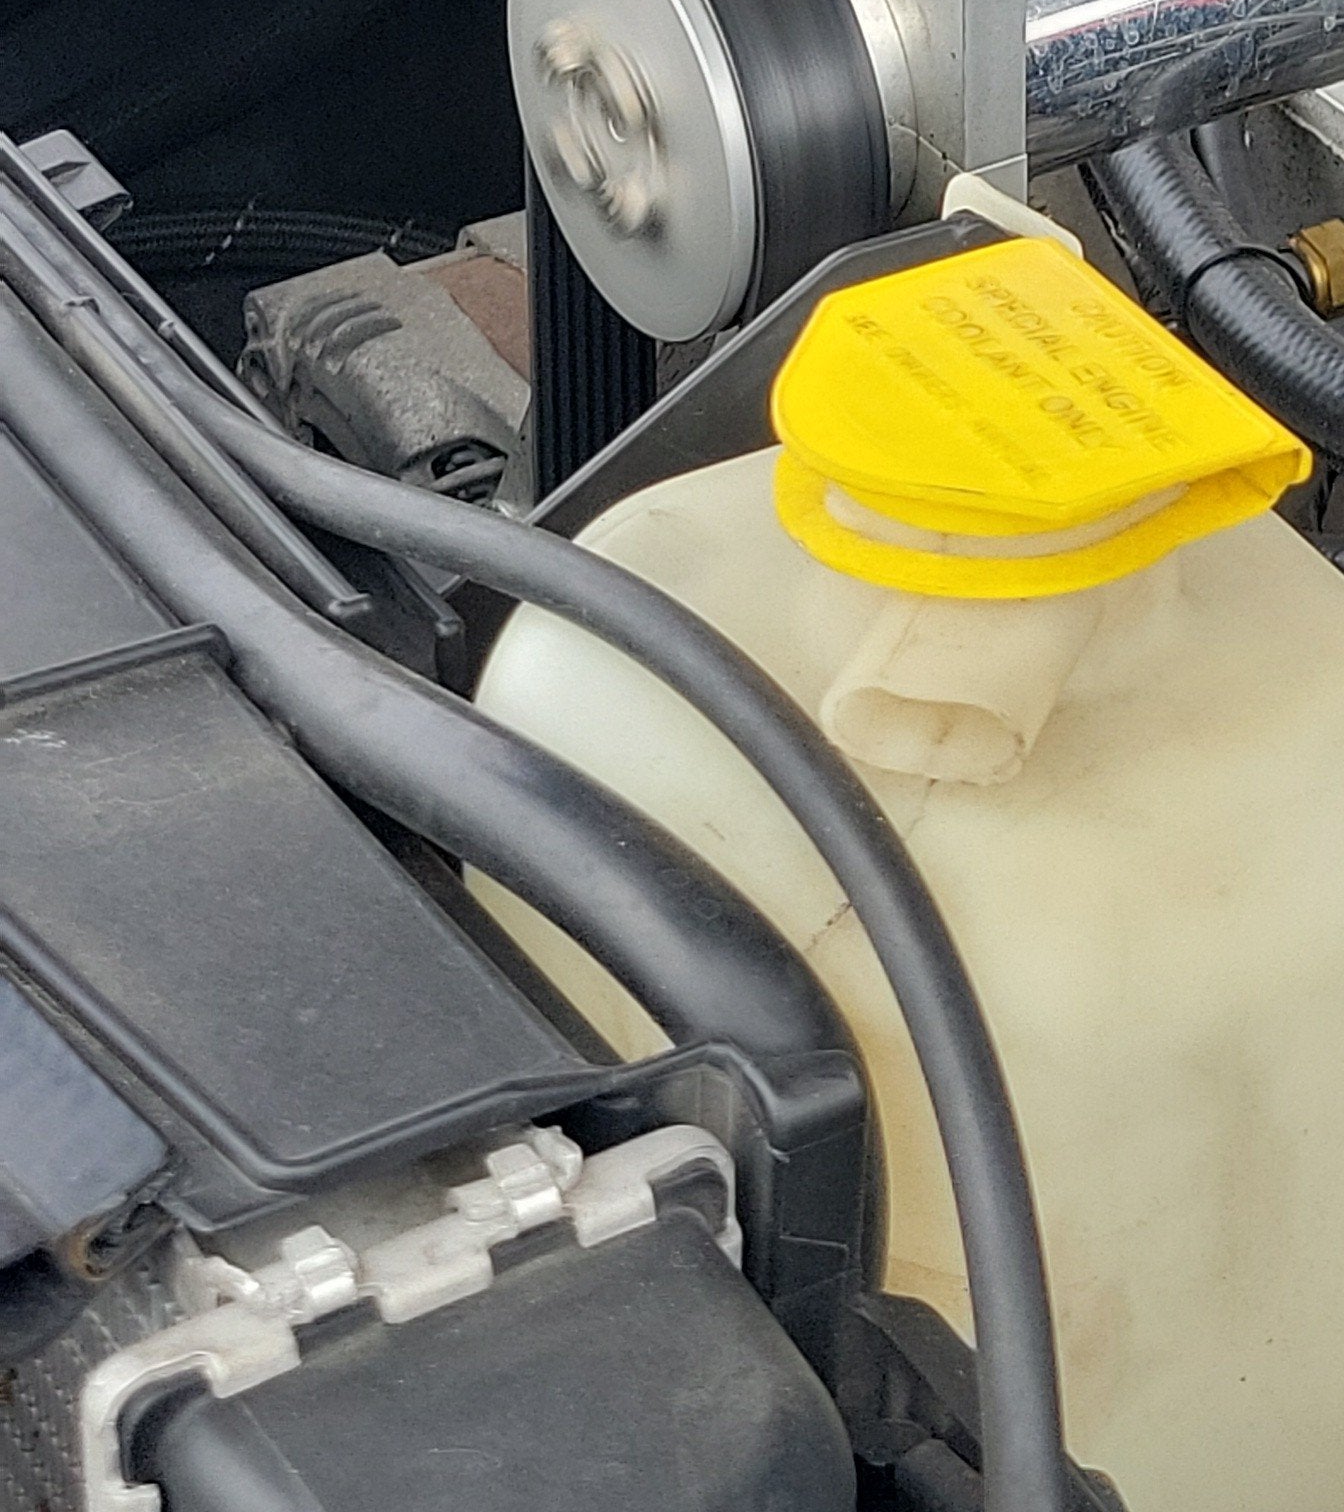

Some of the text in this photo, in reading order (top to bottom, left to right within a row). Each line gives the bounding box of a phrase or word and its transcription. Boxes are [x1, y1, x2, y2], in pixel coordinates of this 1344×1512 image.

[920, 295, 1057, 392] COOLANT
[1038, 392, 1130, 453] ONLY
[964, 274, 1080, 363] SPECIAL
[1067, 361, 1190, 454] ENGINE
[1069, 296, 1194, 391] CAUTION
